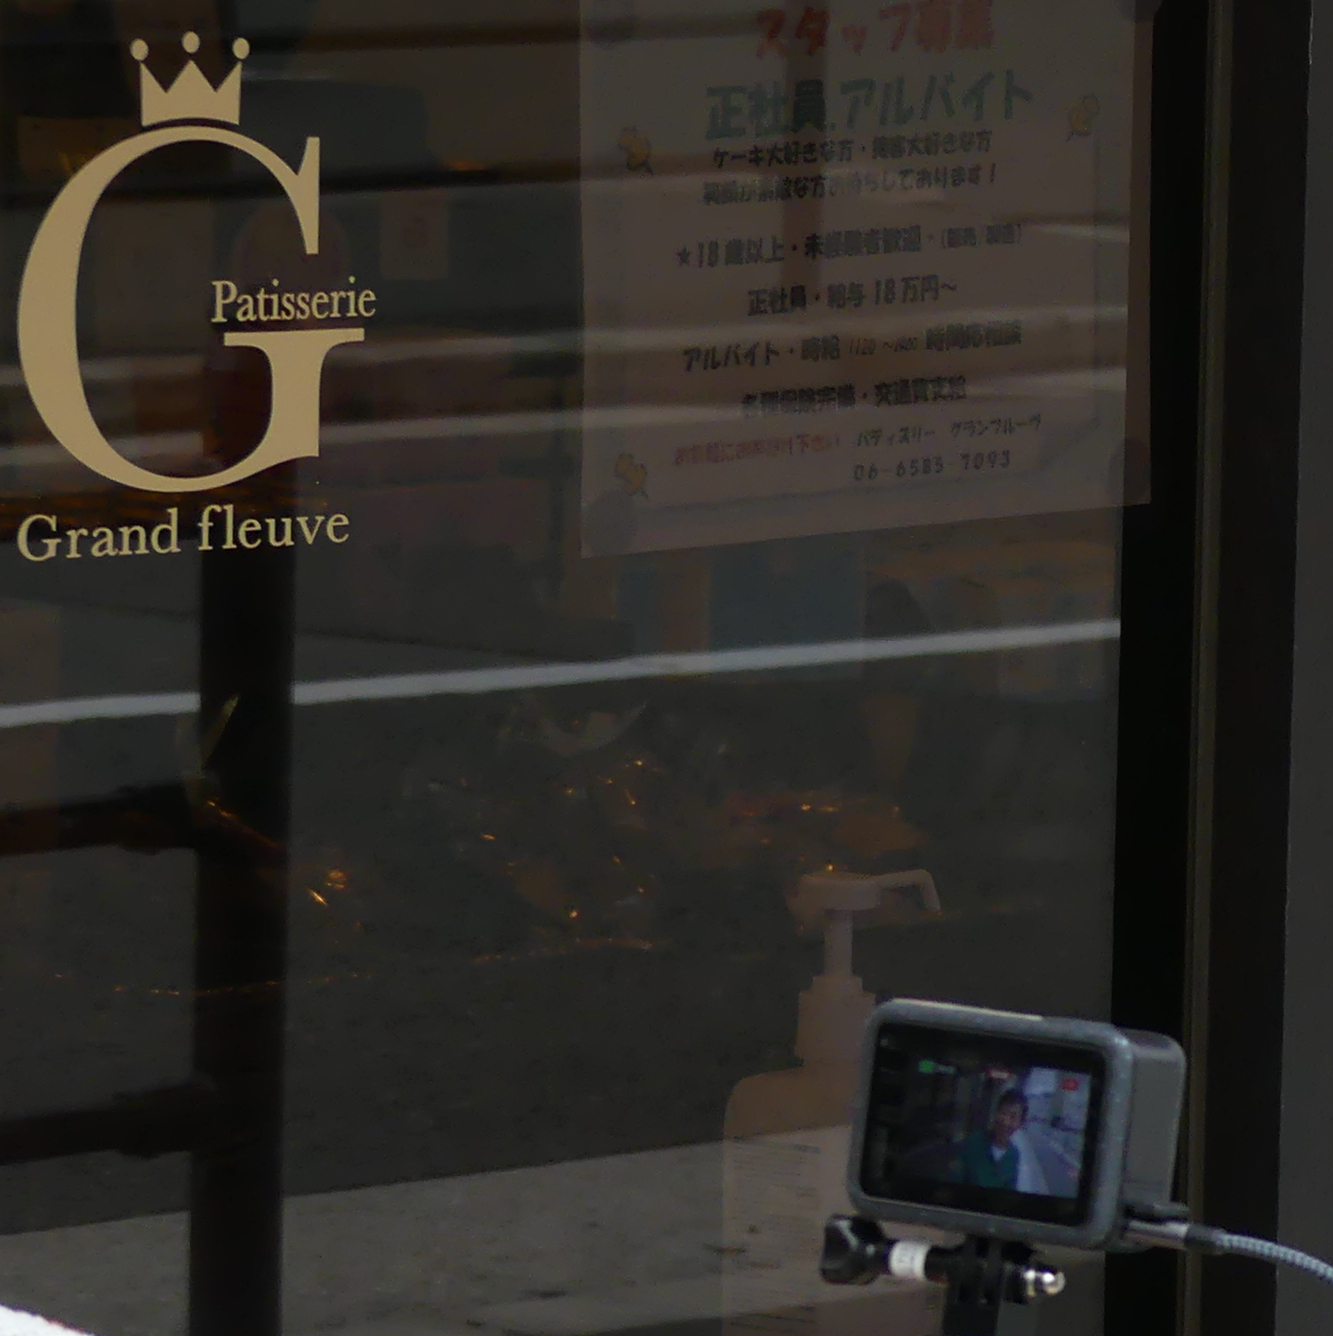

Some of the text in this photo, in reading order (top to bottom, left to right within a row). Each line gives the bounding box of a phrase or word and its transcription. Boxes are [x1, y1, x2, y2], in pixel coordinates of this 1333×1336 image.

[17, 125, 365, 493] G
[211, 276, 377, 324] Patisserie
[17, 504, 350, 561] Grand fleuve
